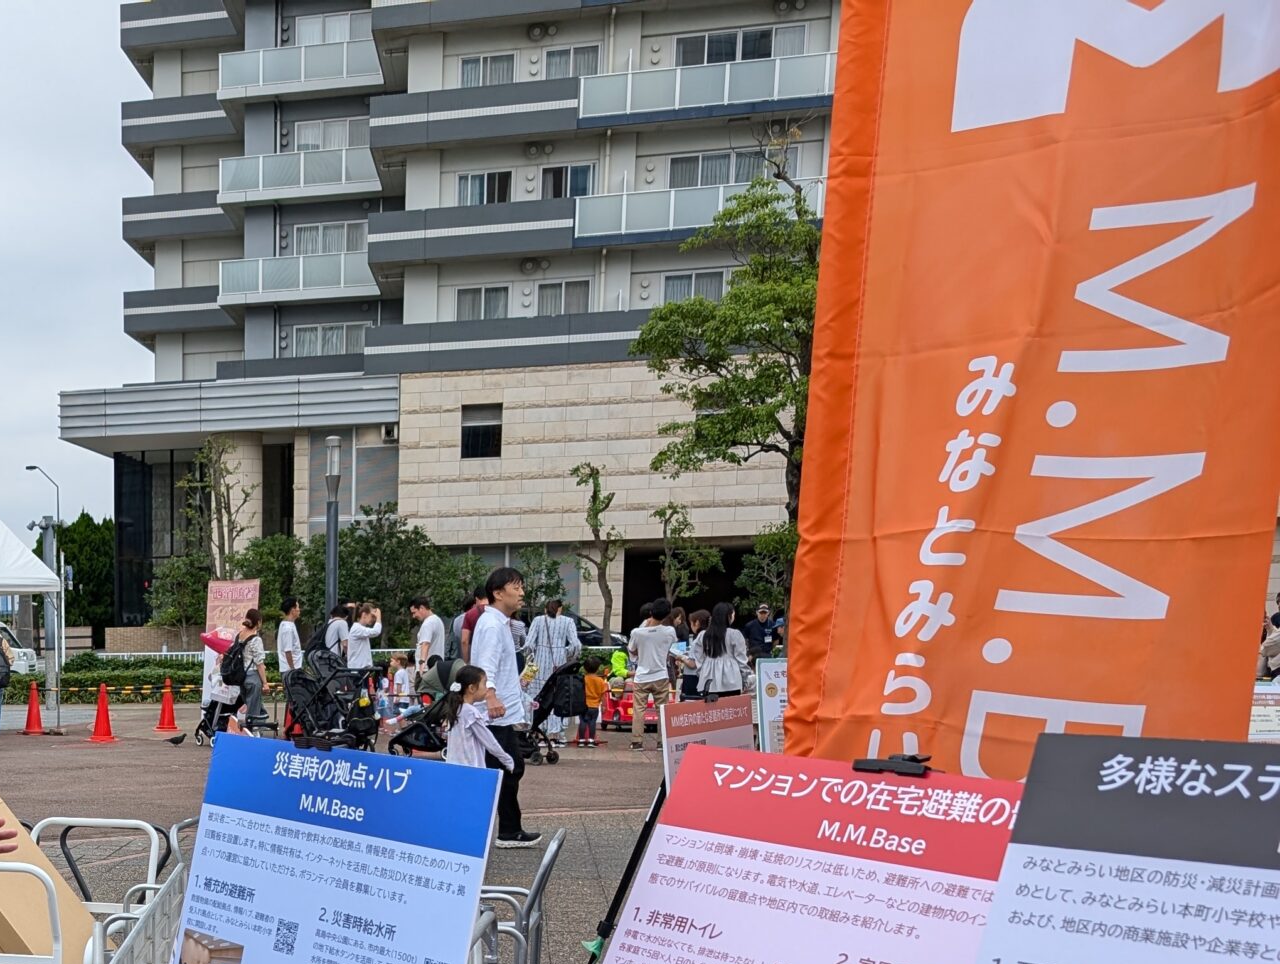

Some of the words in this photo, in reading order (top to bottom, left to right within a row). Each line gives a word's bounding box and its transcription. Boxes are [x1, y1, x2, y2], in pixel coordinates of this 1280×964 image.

[272, 751, 413, 794] 災害時の拠点・ハブ
[299, 793, 365, 822] M.M.Base
[712, 762, 1021, 830] マンションでの在宅避難の
[817, 819, 927, 856] M.M.Base
[665, 834, 995, 903] マンションは倒壊・崩壊・延焼のリスクは低いため、避難所への避難では
[1022, 855, 1280, 900] みなとみらい地区の防災・減災計画
[318, 907, 329, 923] 2.
[331, 909, 397, 941] 災害時給水所
[632, 906, 642, 923] 1.
[646, 908, 723, 940] 非常用トイレ
[648, 872, 920, 940] 態でのサバイバルの留意点や地区内での取組みを紹介します。
